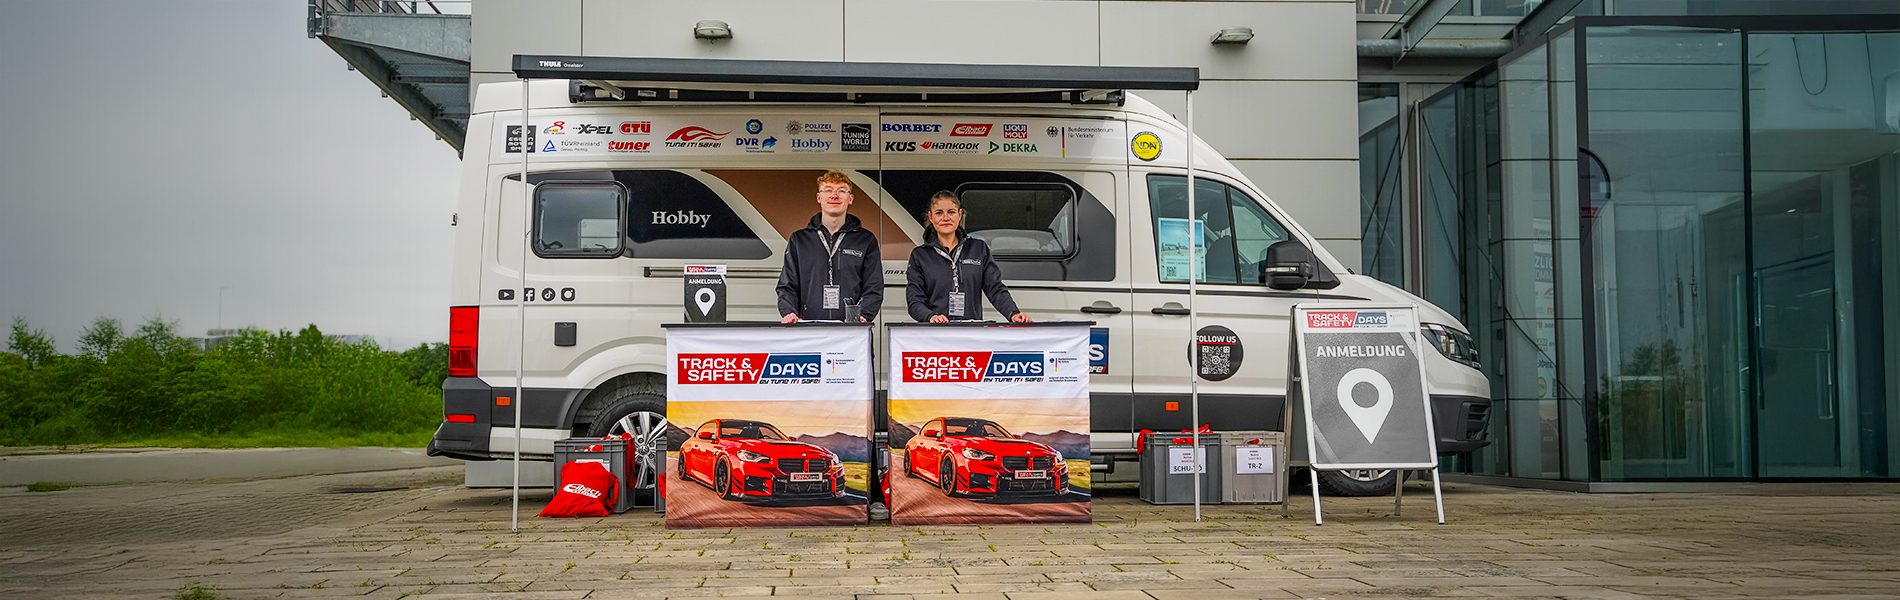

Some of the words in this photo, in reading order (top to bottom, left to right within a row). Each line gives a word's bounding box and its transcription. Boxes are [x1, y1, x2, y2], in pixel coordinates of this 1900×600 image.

[578, 124, 613, 134] XPEL
[621, 121, 651, 133] GTÜ
[882, 123, 942, 133] BORBET
[608, 141, 651, 150] tuner
[736, 138, 758, 146] DVR
[792, 139, 832, 151] Hobby
[885, 142, 916, 152] KÜS
[1004, 144, 1038, 153] DEKRA
[652, 210, 711, 228] Hobby
[1358, 316, 1386, 324] DAYS
[1316, 345, 1405, 357] ANMELDUNG
[679, 357, 735, 369] TRACK
[741, 357, 752, 368] &
[904, 356, 961, 368] TRACK
[965, 356, 976, 367] &
[993, 362, 1042, 374] DAYS
[688, 369, 759, 382] SAFETY
[769, 363, 819, 376] DAYS
[912, 368, 983, 380] SAFETY
